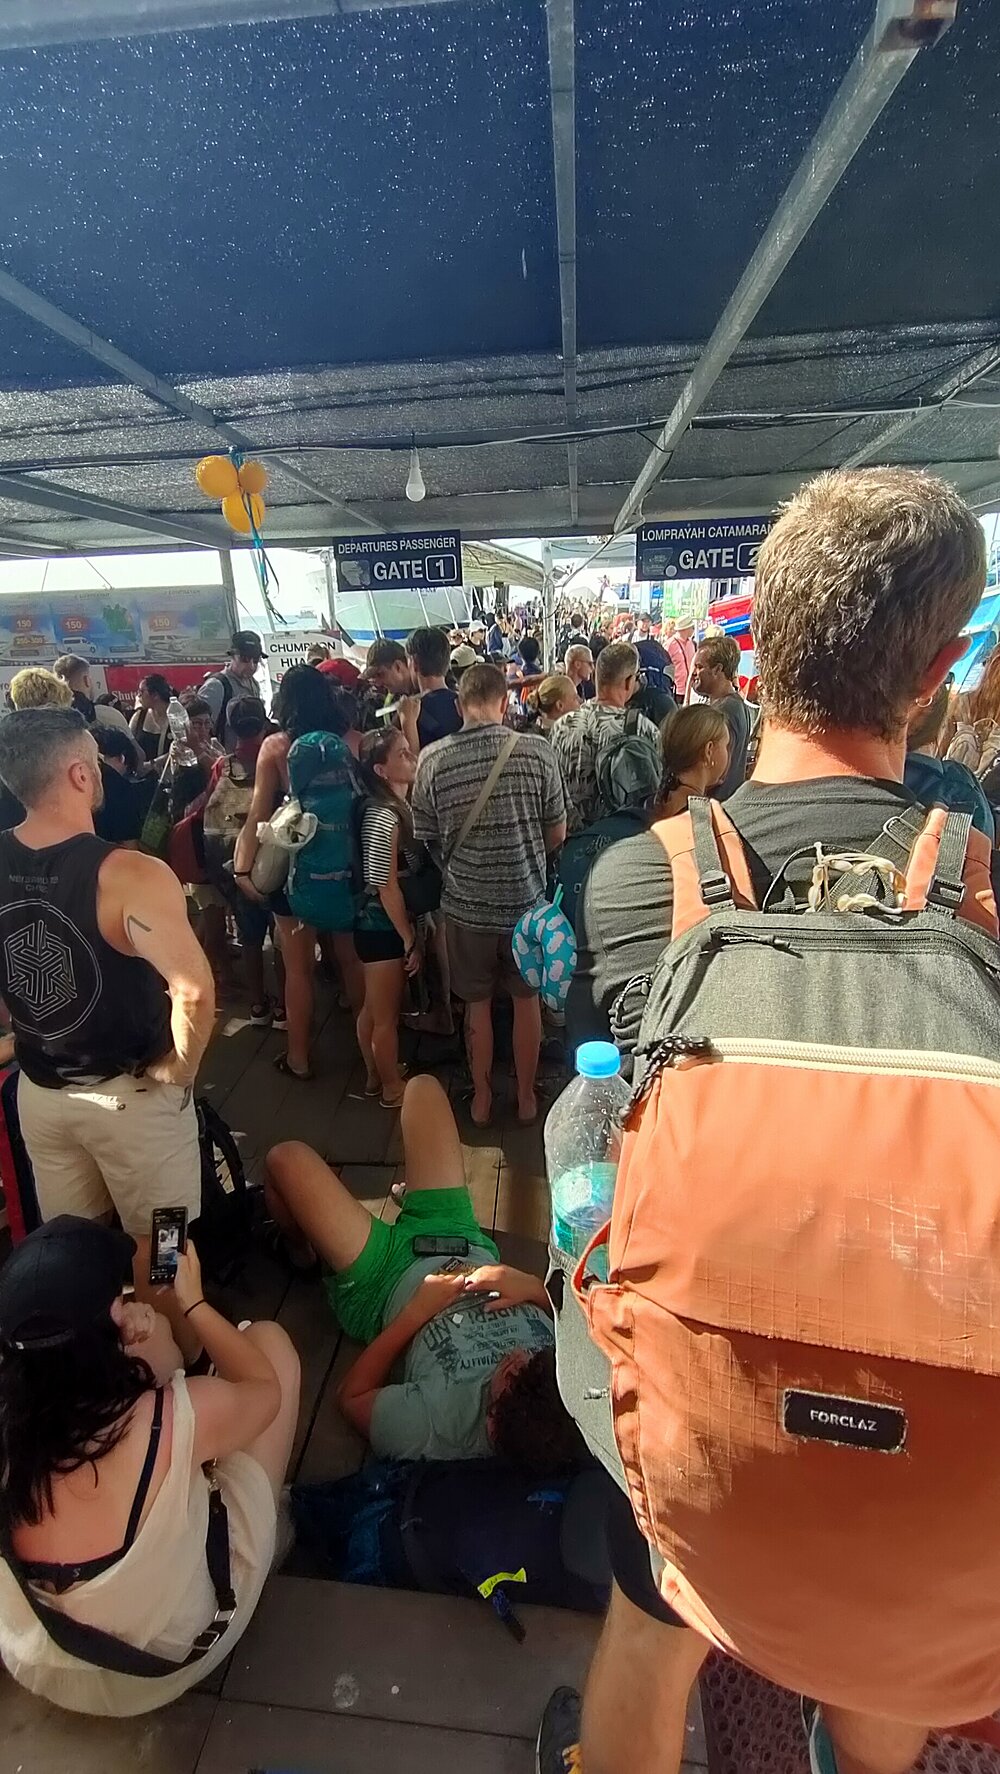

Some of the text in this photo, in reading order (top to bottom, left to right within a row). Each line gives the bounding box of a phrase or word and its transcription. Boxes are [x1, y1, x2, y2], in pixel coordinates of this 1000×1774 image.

[641, 527, 706, 541] LOMPRAYAH
[338, 537, 456, 554] DEPARTURES PASSENGER
[678, 547, 735, 570] GATE
[373, 559, 445, 581] GATE 1
[16, 619, 32, 628] 150
[65, 620, 82, 630] 150
[152, 617, 170, 628] 150
[269, 641, 336, 653] CHUMPN
[809, 1409, 878, 1432] FORCLAZ
